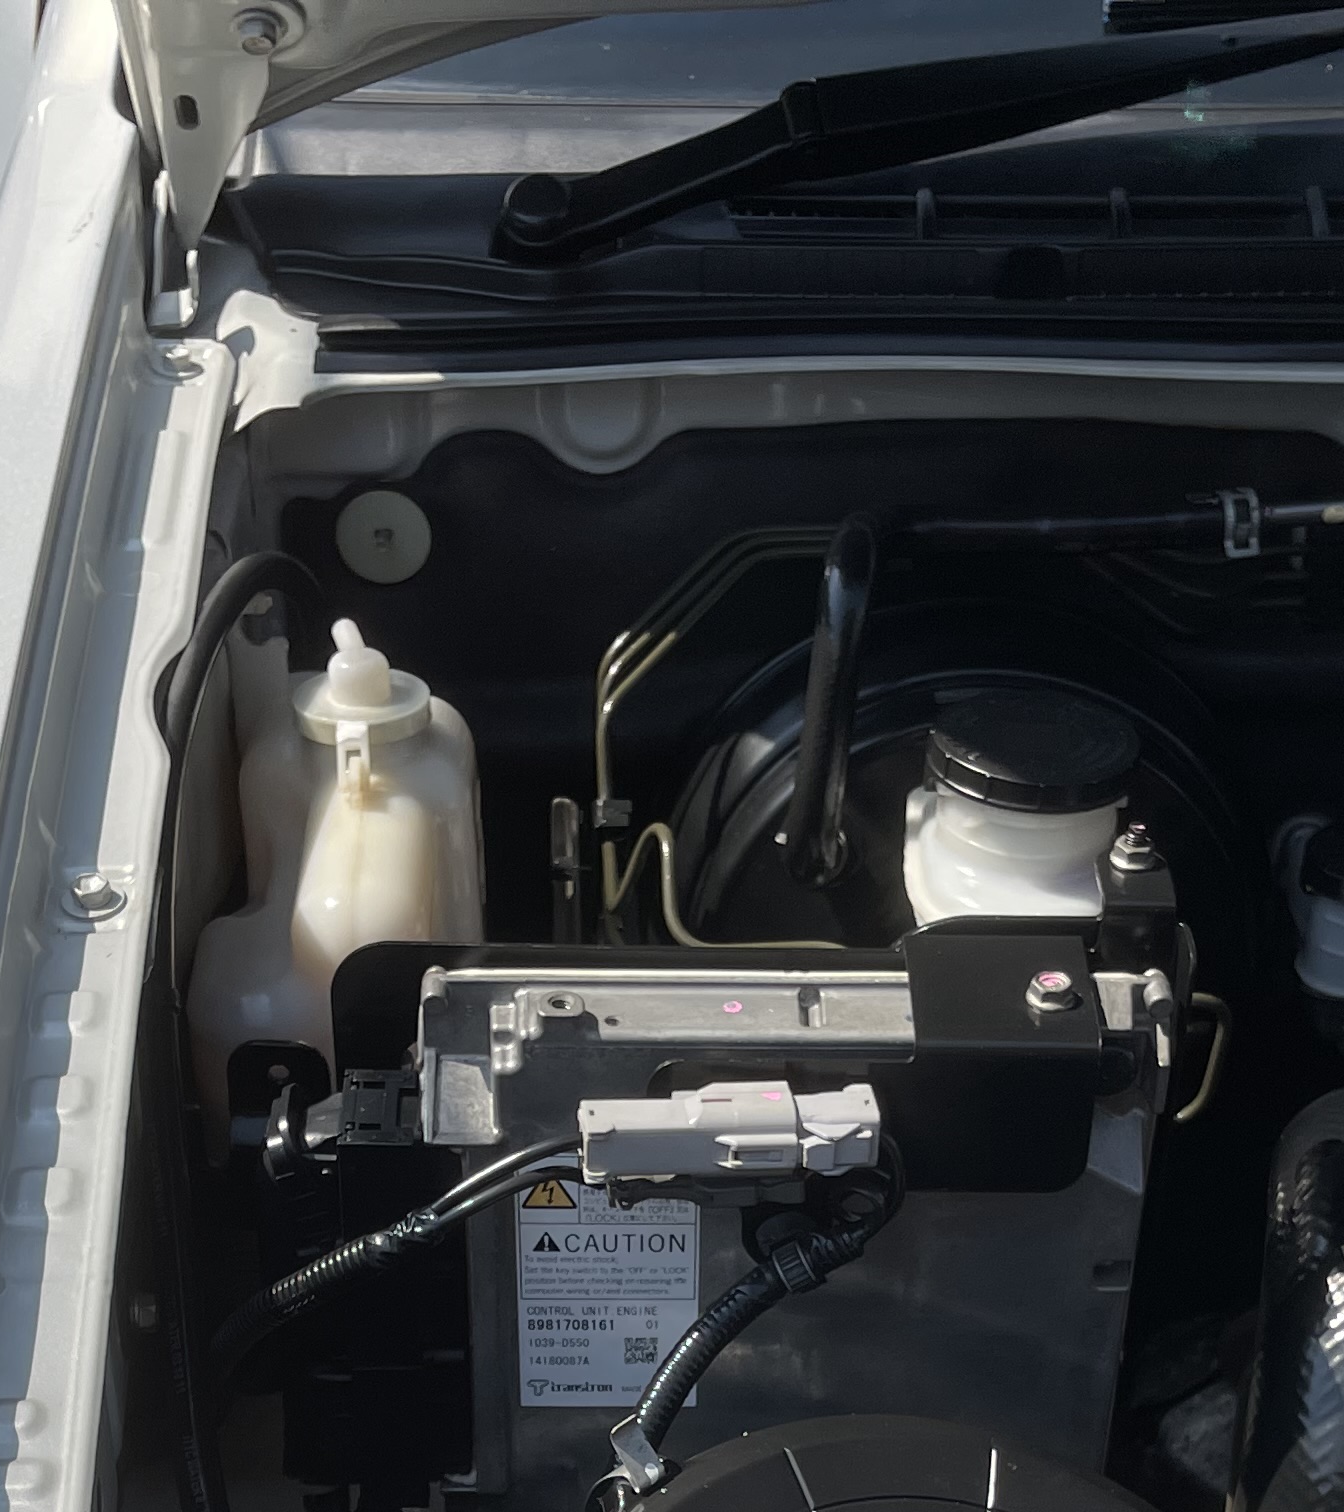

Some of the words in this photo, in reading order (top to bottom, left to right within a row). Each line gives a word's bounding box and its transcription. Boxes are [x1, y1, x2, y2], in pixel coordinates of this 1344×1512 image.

[564, 1233, 686, 1253] CAUTION
[527, 1306, 574, 1316] CONTROL
[582, 1306, 609, 1316] UNIT
[617, 1306, 658, 1317] ENGINE
[527, 1319, 615, 1331] 8981708161
